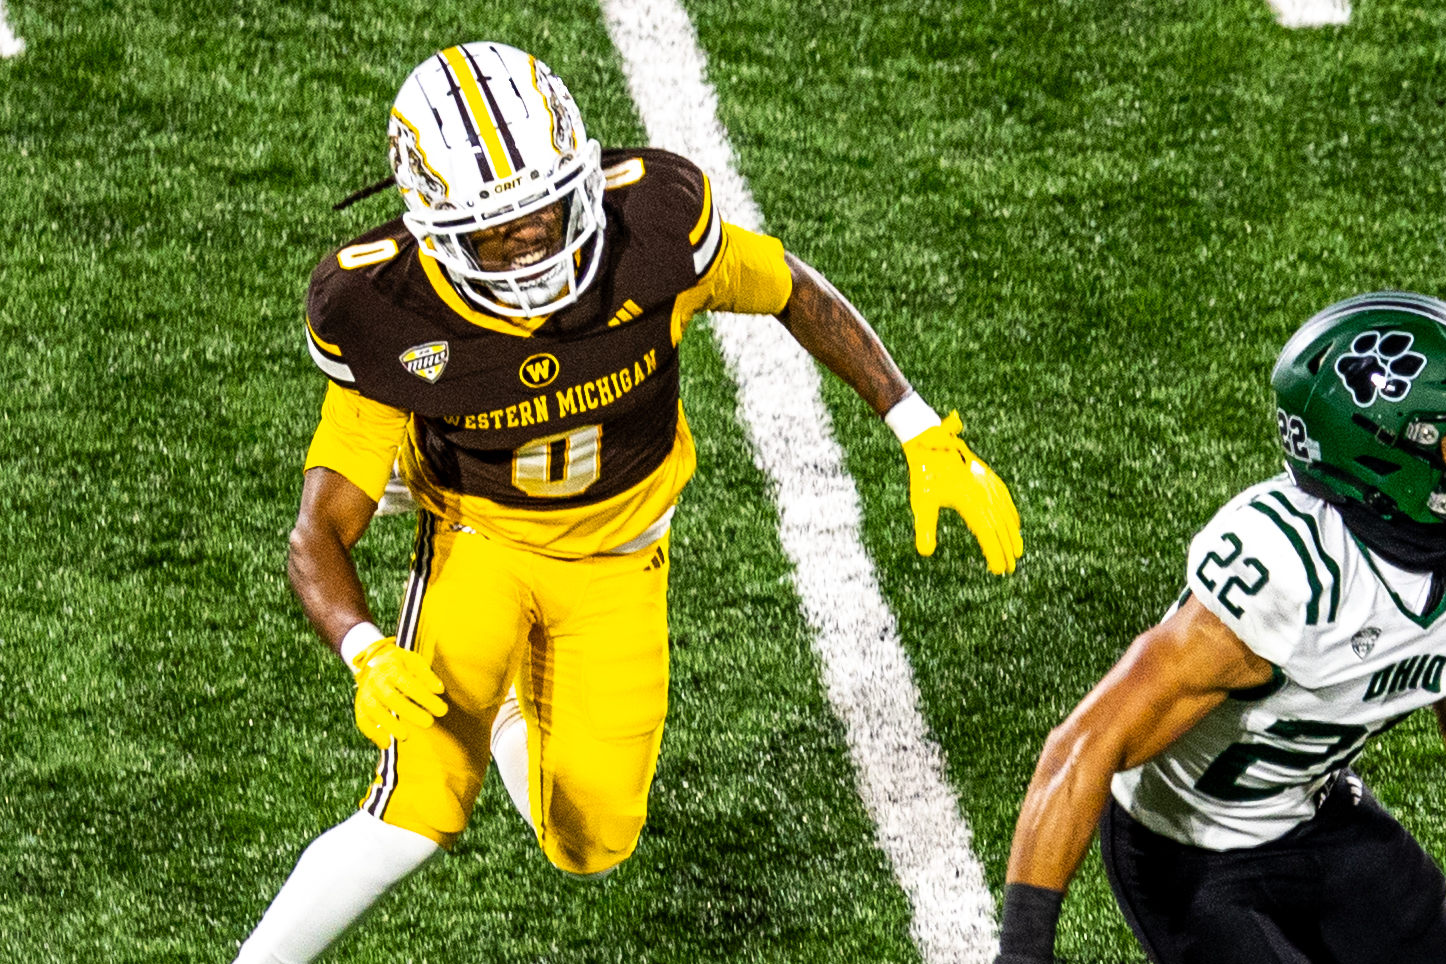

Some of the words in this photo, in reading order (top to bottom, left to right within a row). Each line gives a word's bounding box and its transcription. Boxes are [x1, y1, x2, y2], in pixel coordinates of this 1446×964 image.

[494, 176, 523, 194] GRIT
[336, 238, 400, 270] 0
[526, 358, 551, 383] W
[556, 348, 657, 419] MICHIGAN
[512, 423, 603, 499] 0
[1196, 532, 1270, 620] 22
